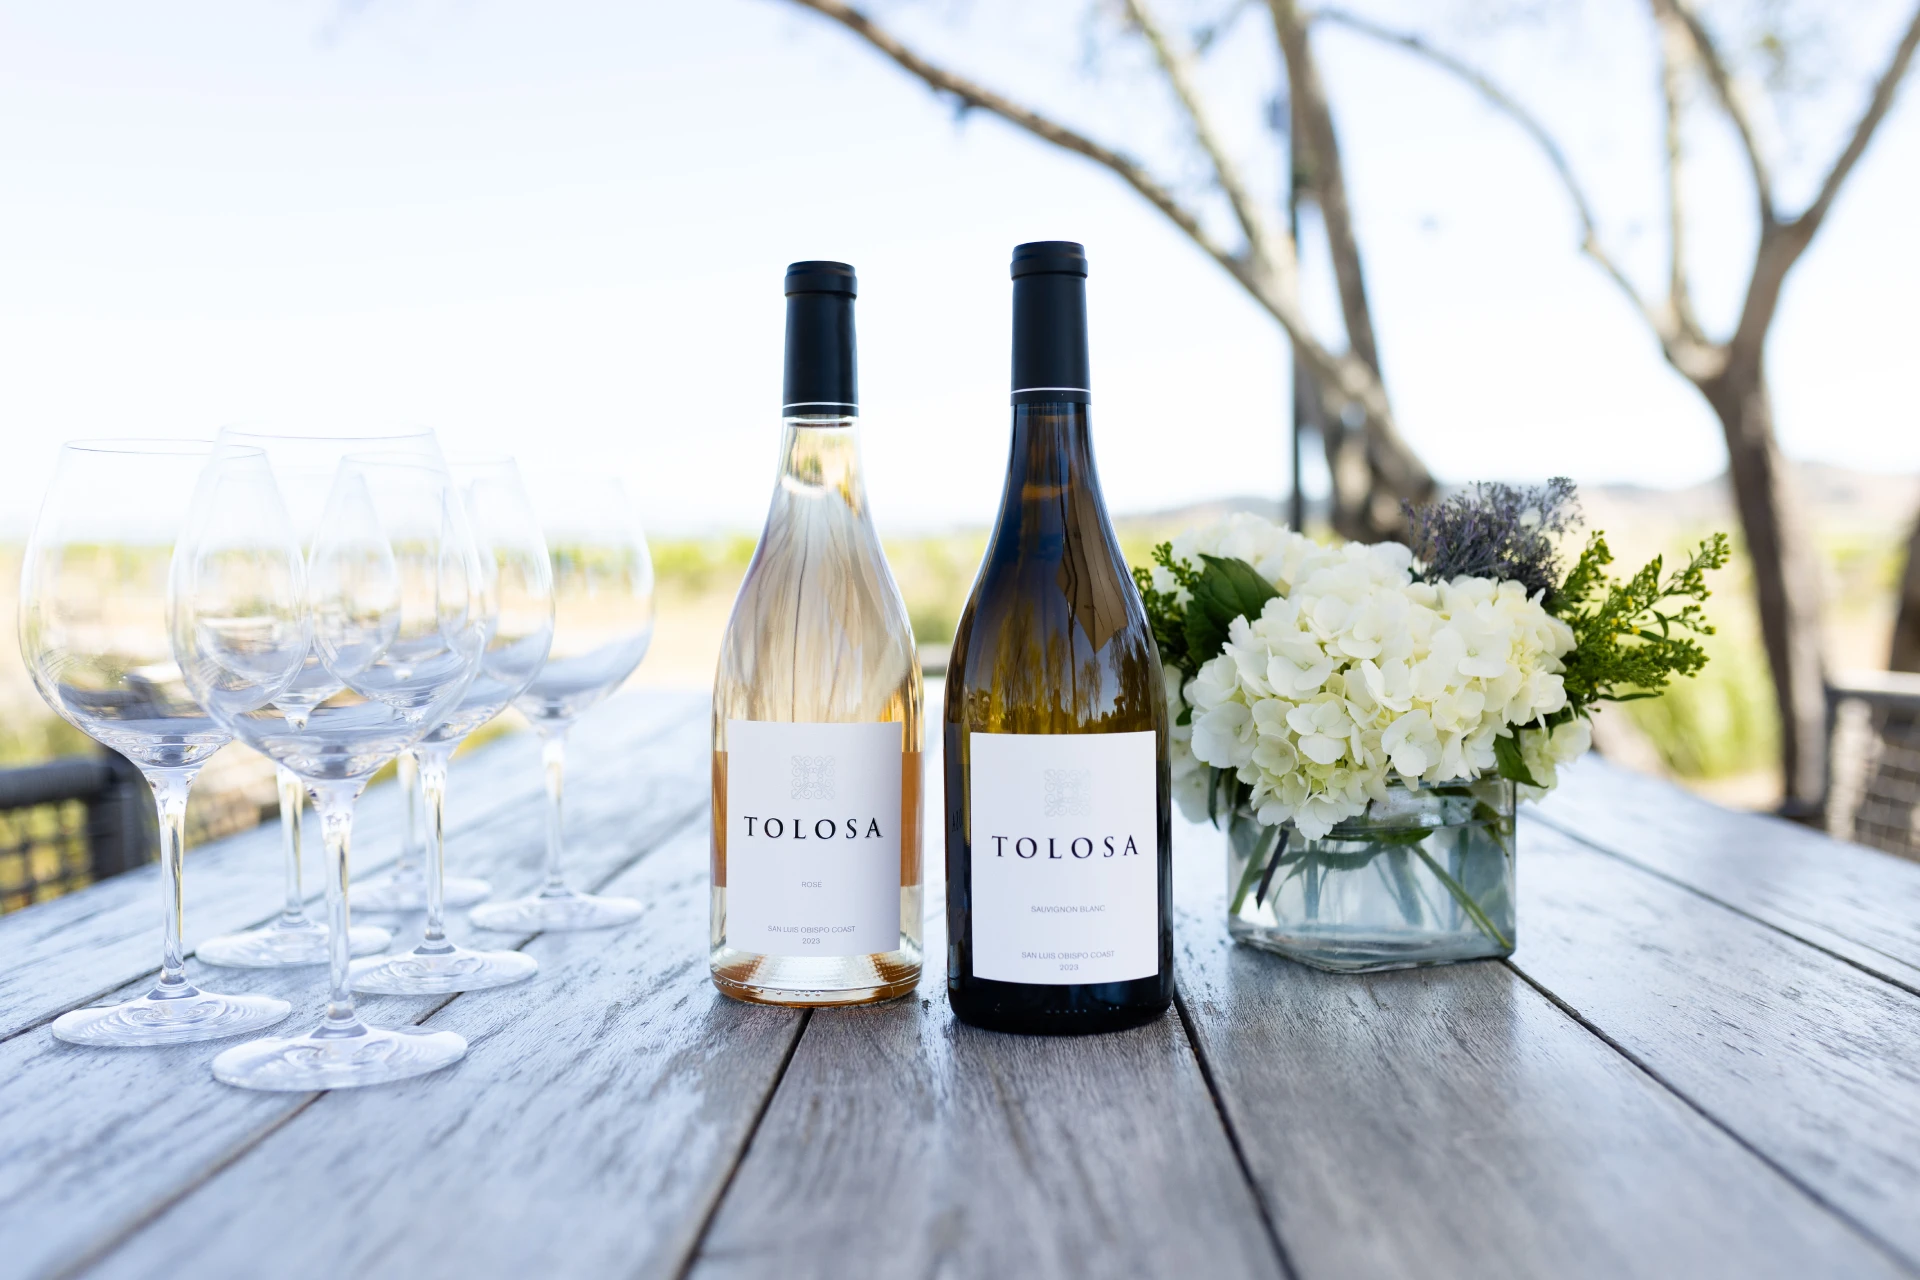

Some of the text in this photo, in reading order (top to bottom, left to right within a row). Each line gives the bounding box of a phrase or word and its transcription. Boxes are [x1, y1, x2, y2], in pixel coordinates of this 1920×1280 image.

[743, 816, 884, 840] TOLOSA
[991, 834, 1139, 859] TOLOSA
[1031, 905, 1105, 913] SAUVIGNON BLANC
[767, 925, 782, 933] SAN
[831, 925, 856, 934] COAST
[802, 937, 821, 945] 2023
[1021, 950, 1115, 960] SAN LUIS OBISPO COAST
[1059, 963, 1079, 971] 2023
